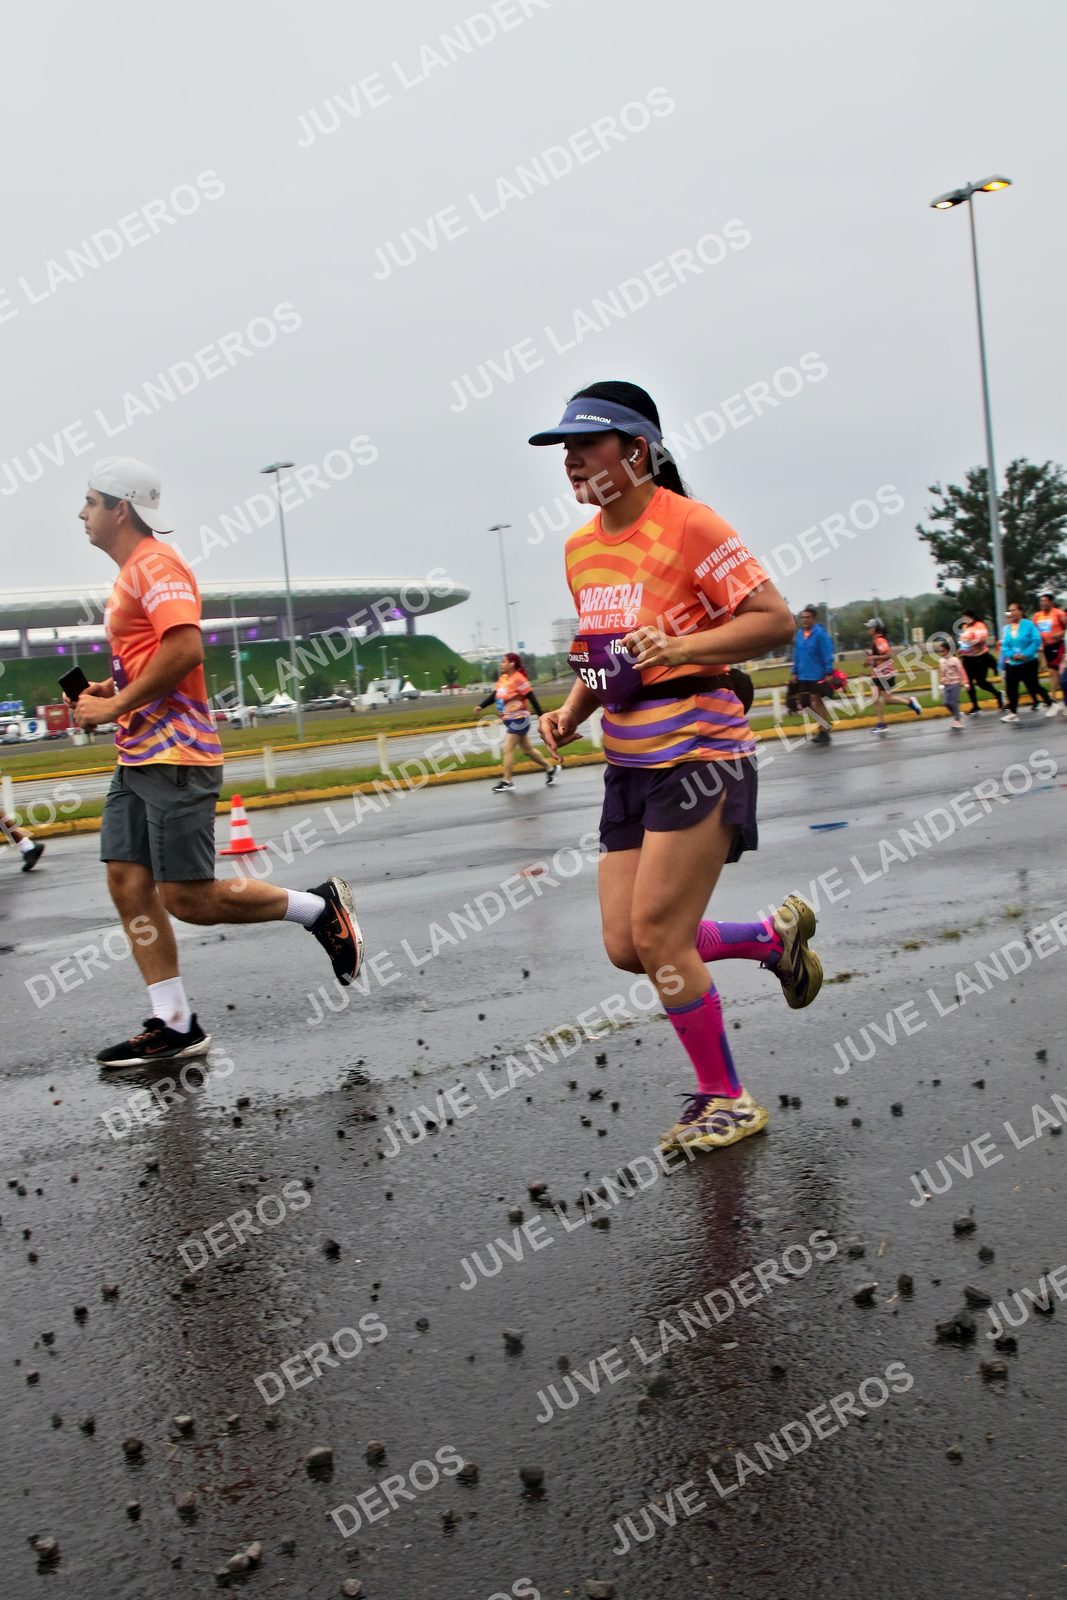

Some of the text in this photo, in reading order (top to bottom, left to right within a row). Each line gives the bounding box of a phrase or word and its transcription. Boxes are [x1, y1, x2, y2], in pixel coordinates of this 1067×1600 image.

[575, 414, 611, 424] SALOMON
[580, 582, 644, 613] CARRERA
[579, 613, 621, 630] MNILIFE
[580, 668, 607, 690] 581
